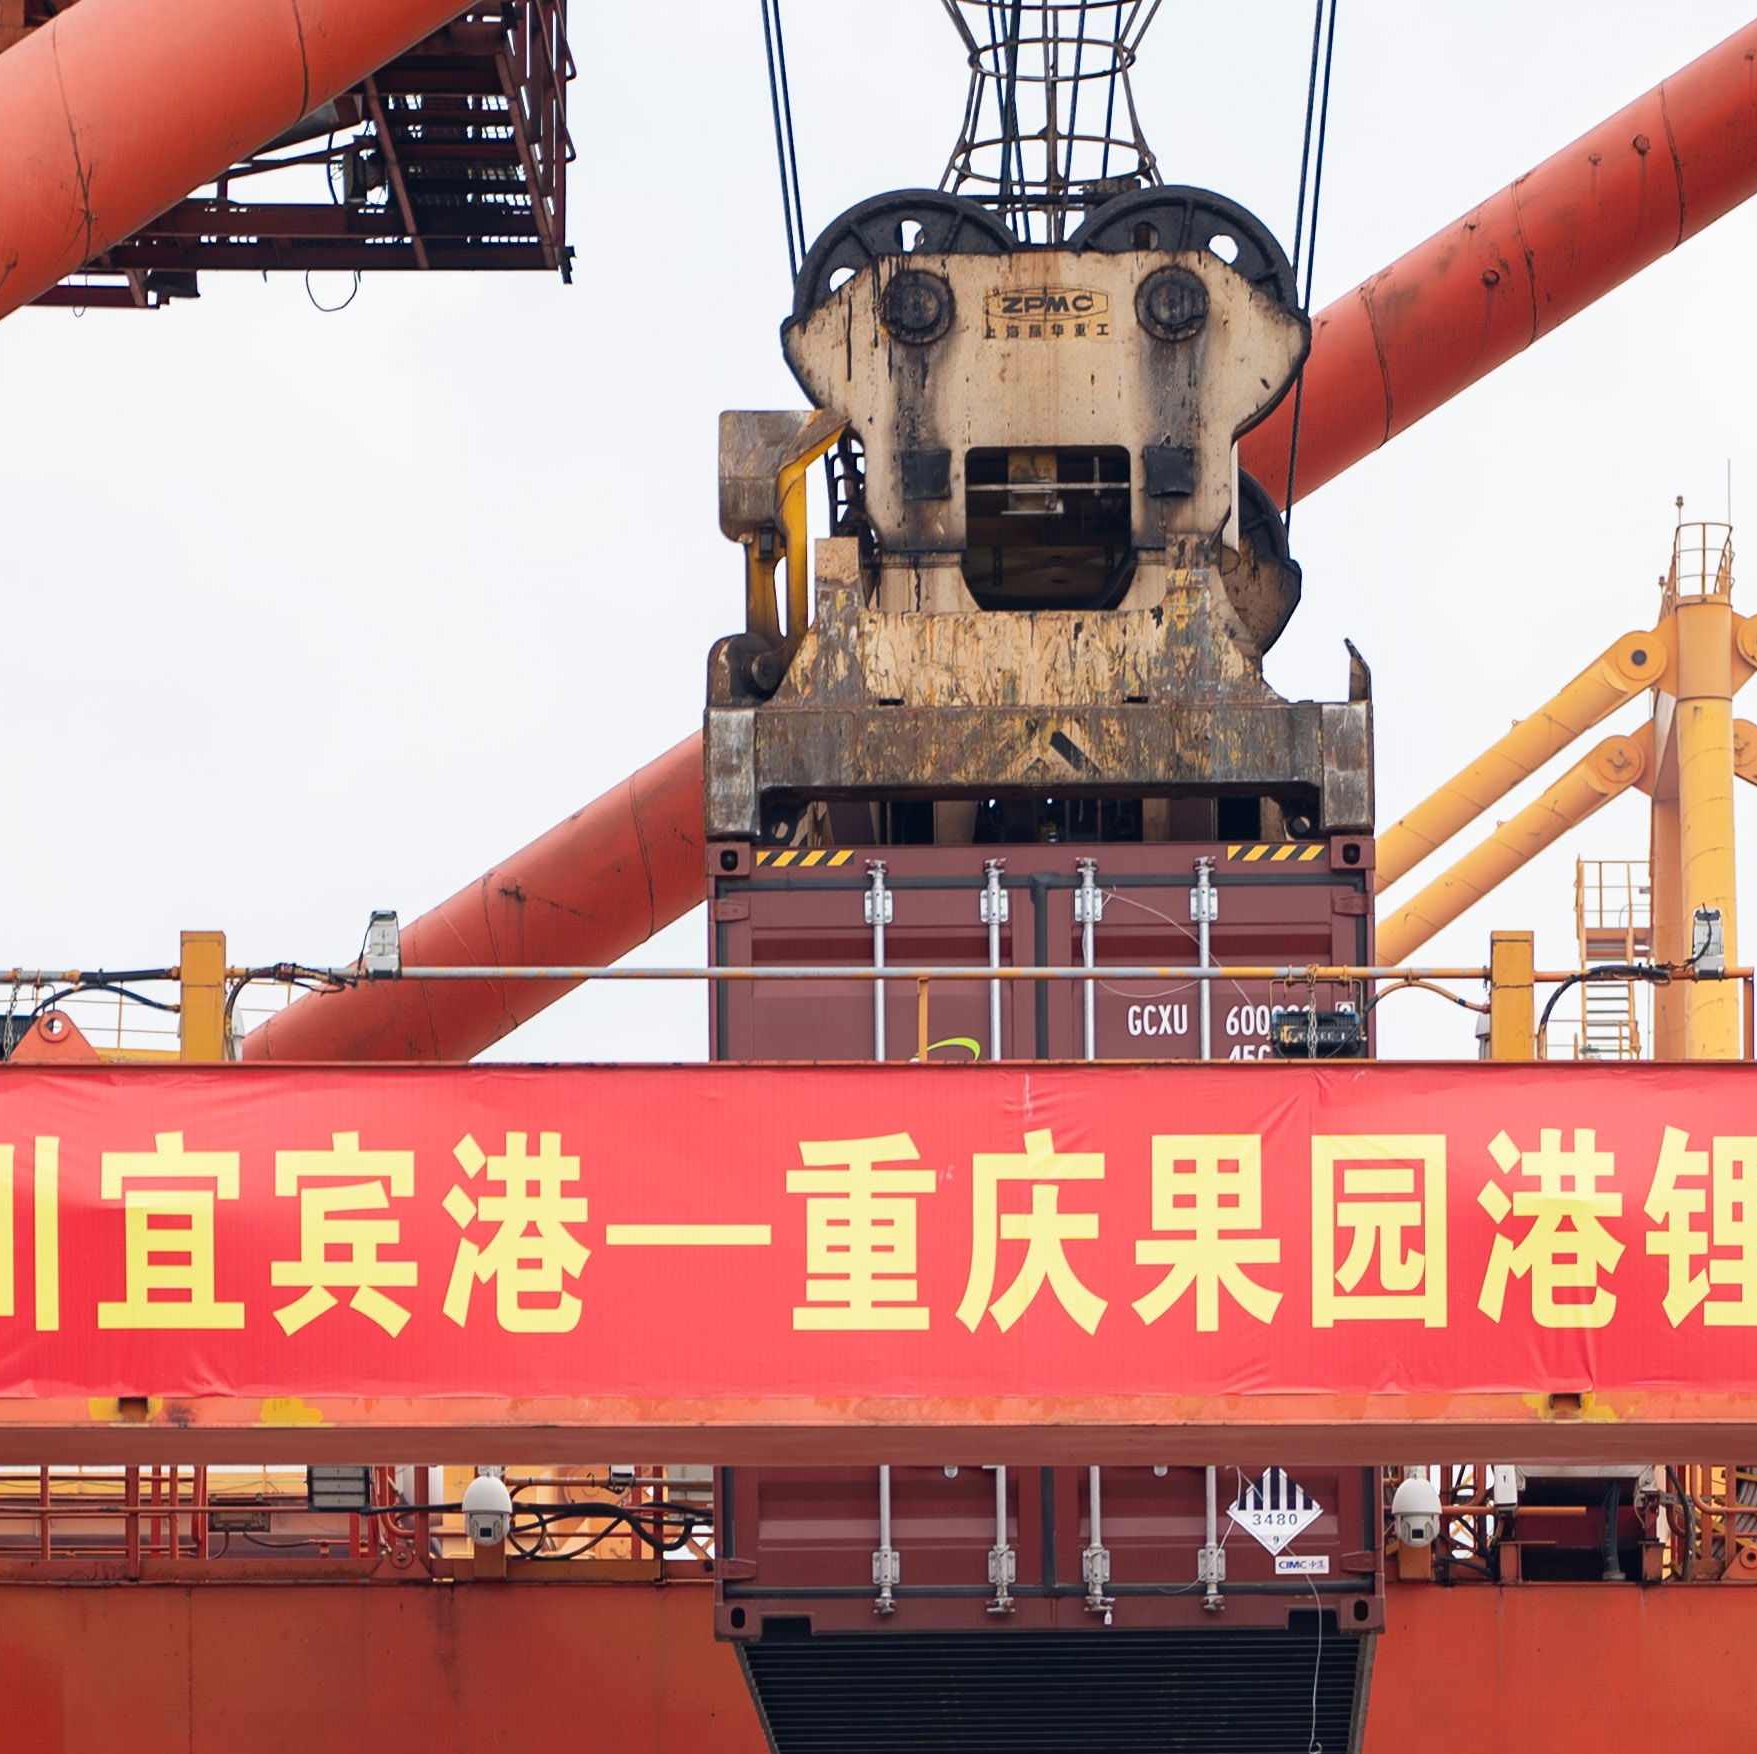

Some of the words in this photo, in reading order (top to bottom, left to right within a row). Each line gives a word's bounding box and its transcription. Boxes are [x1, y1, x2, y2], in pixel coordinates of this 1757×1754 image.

[1001, 294, 1094, 314] ZPMC
[1127, 1004, 1188, 1036] GCXU
[1225, 1004, 1312, 1037] 600
[1252, 1513, 1298, 1526] 3480
[1273, 1535, 1280, 1545] 9
[1278, 1560, 1307, 1569] CIMC
